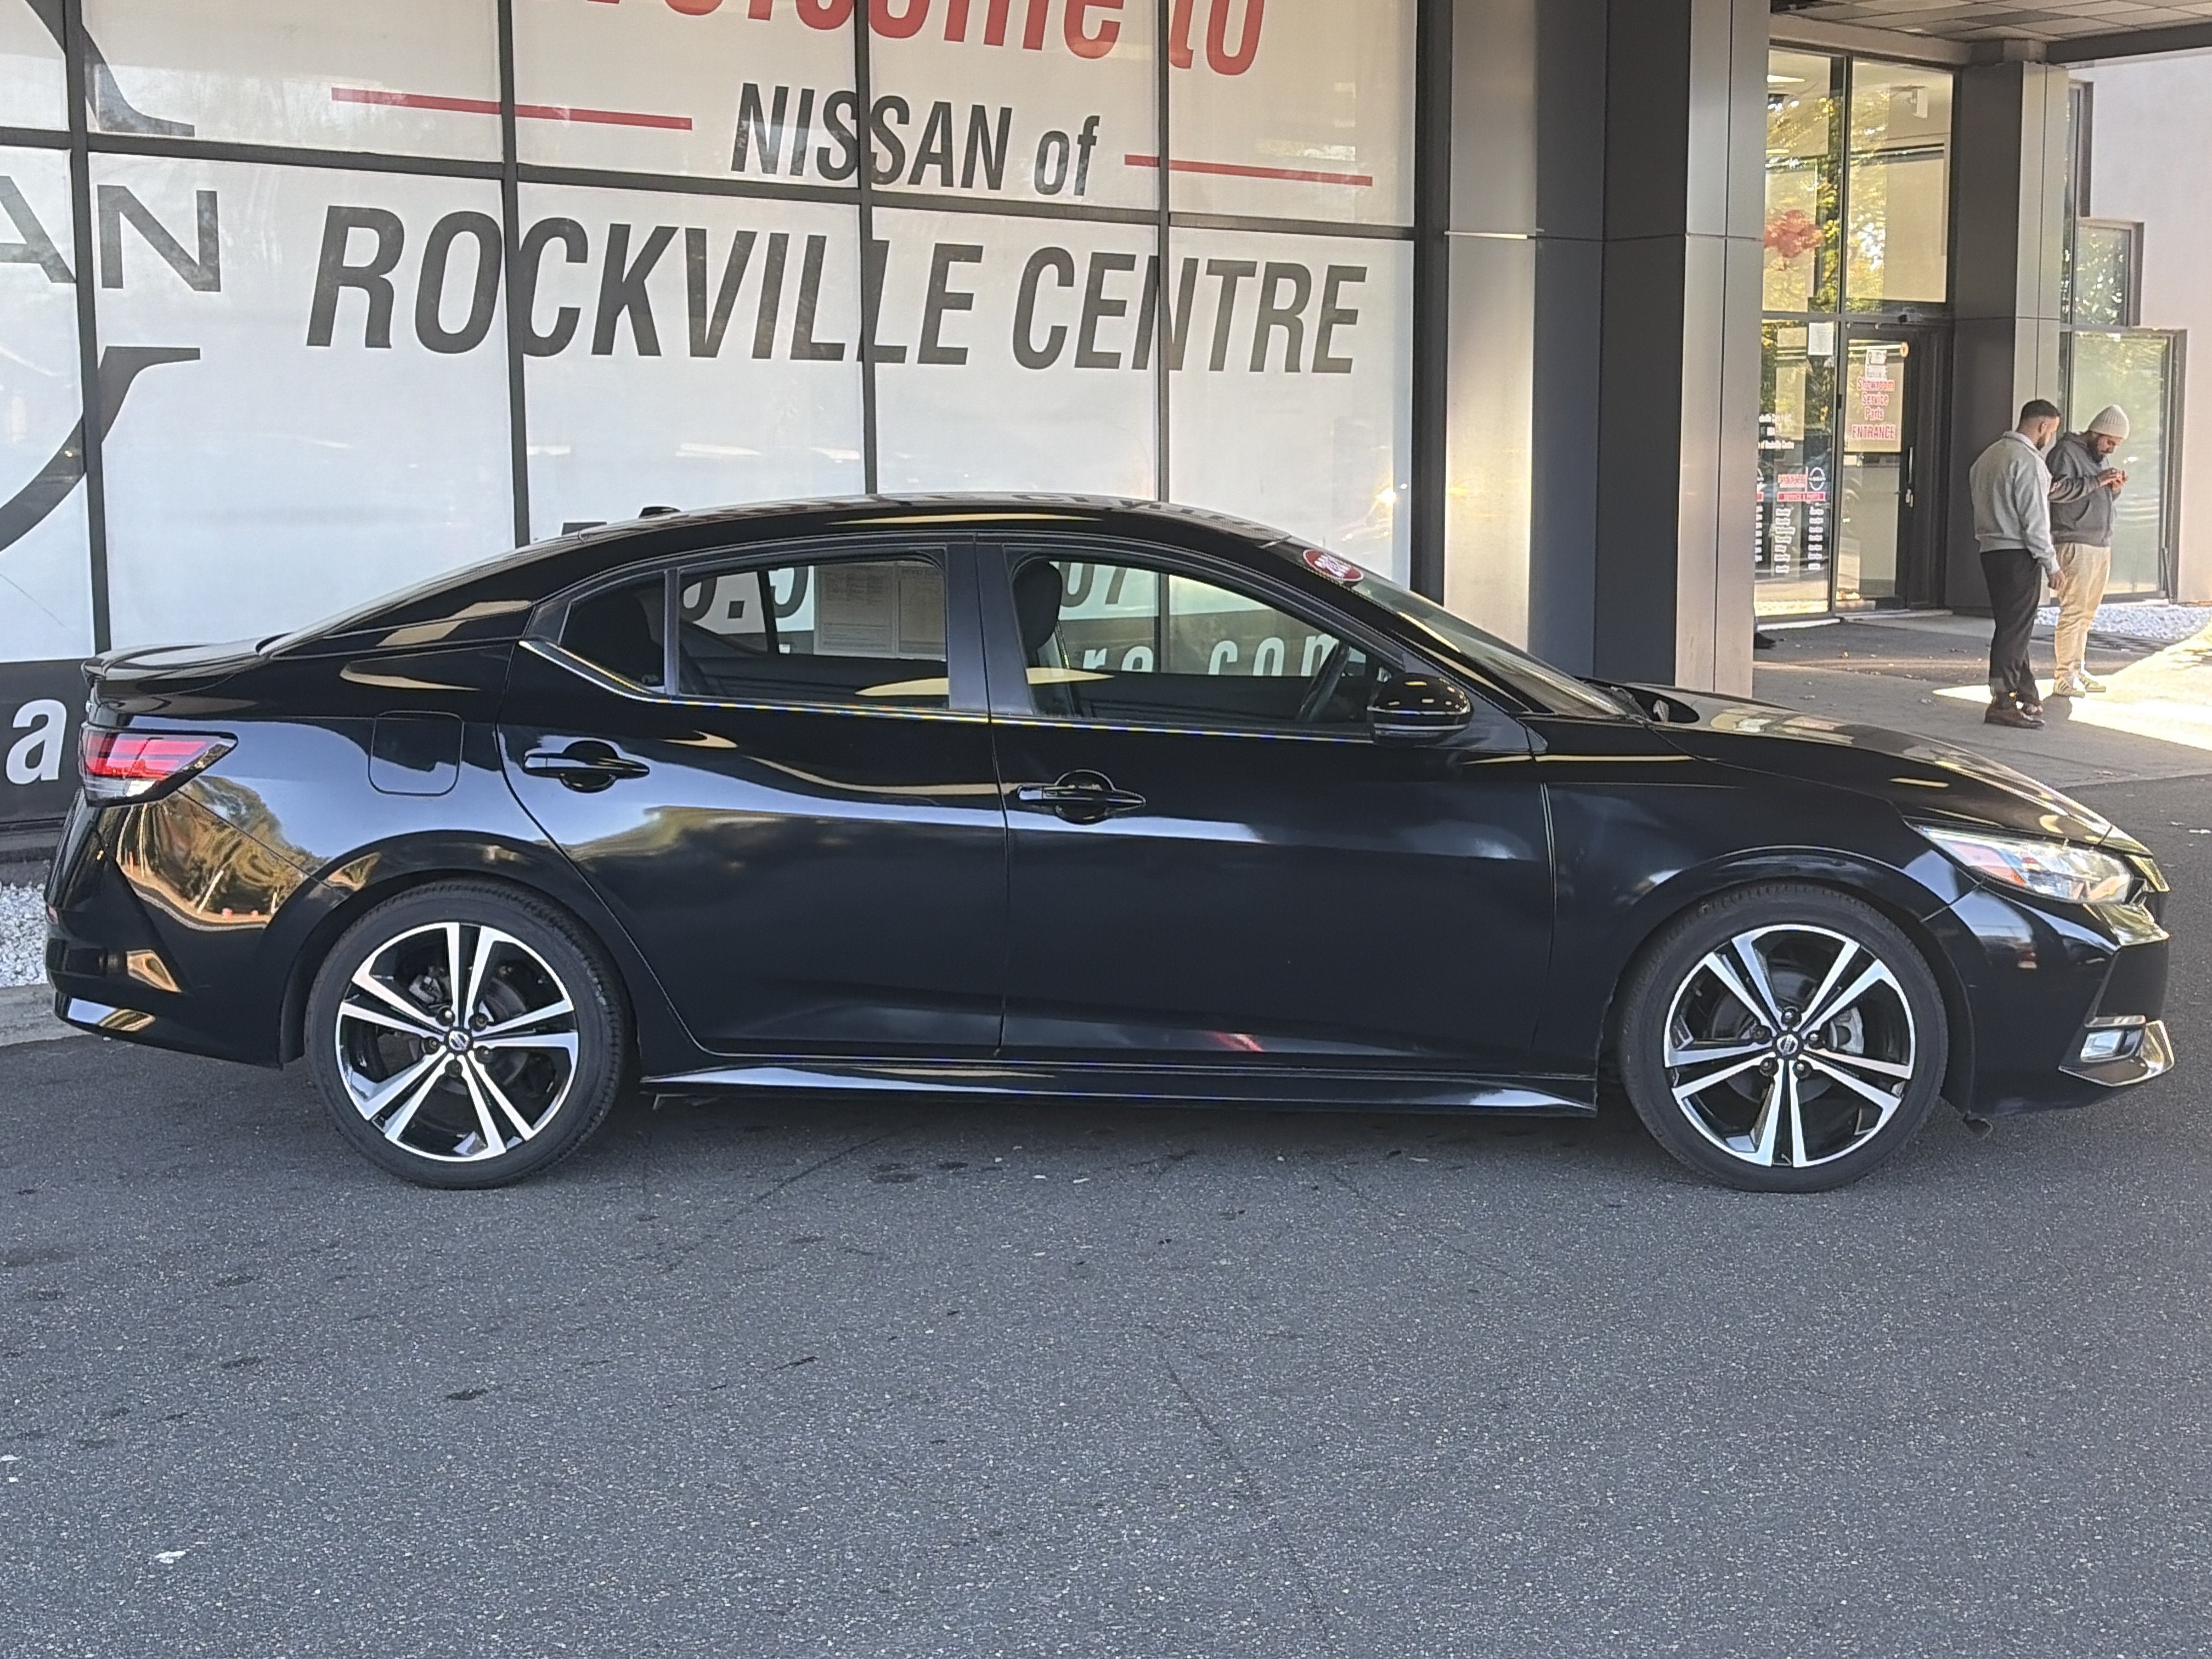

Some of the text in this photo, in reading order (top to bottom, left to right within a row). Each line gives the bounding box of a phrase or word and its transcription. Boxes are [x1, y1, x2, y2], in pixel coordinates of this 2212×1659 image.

[731, 82, 1100, 196] NISSAN of
[306, 205, 1368, 374] ROCKVILLE CENTRE
[1861, 392, 1889, 406] Service
[1865, 407, 1884, 420] Parts
[1852, 424, 1896, 439] ENTRANCE
